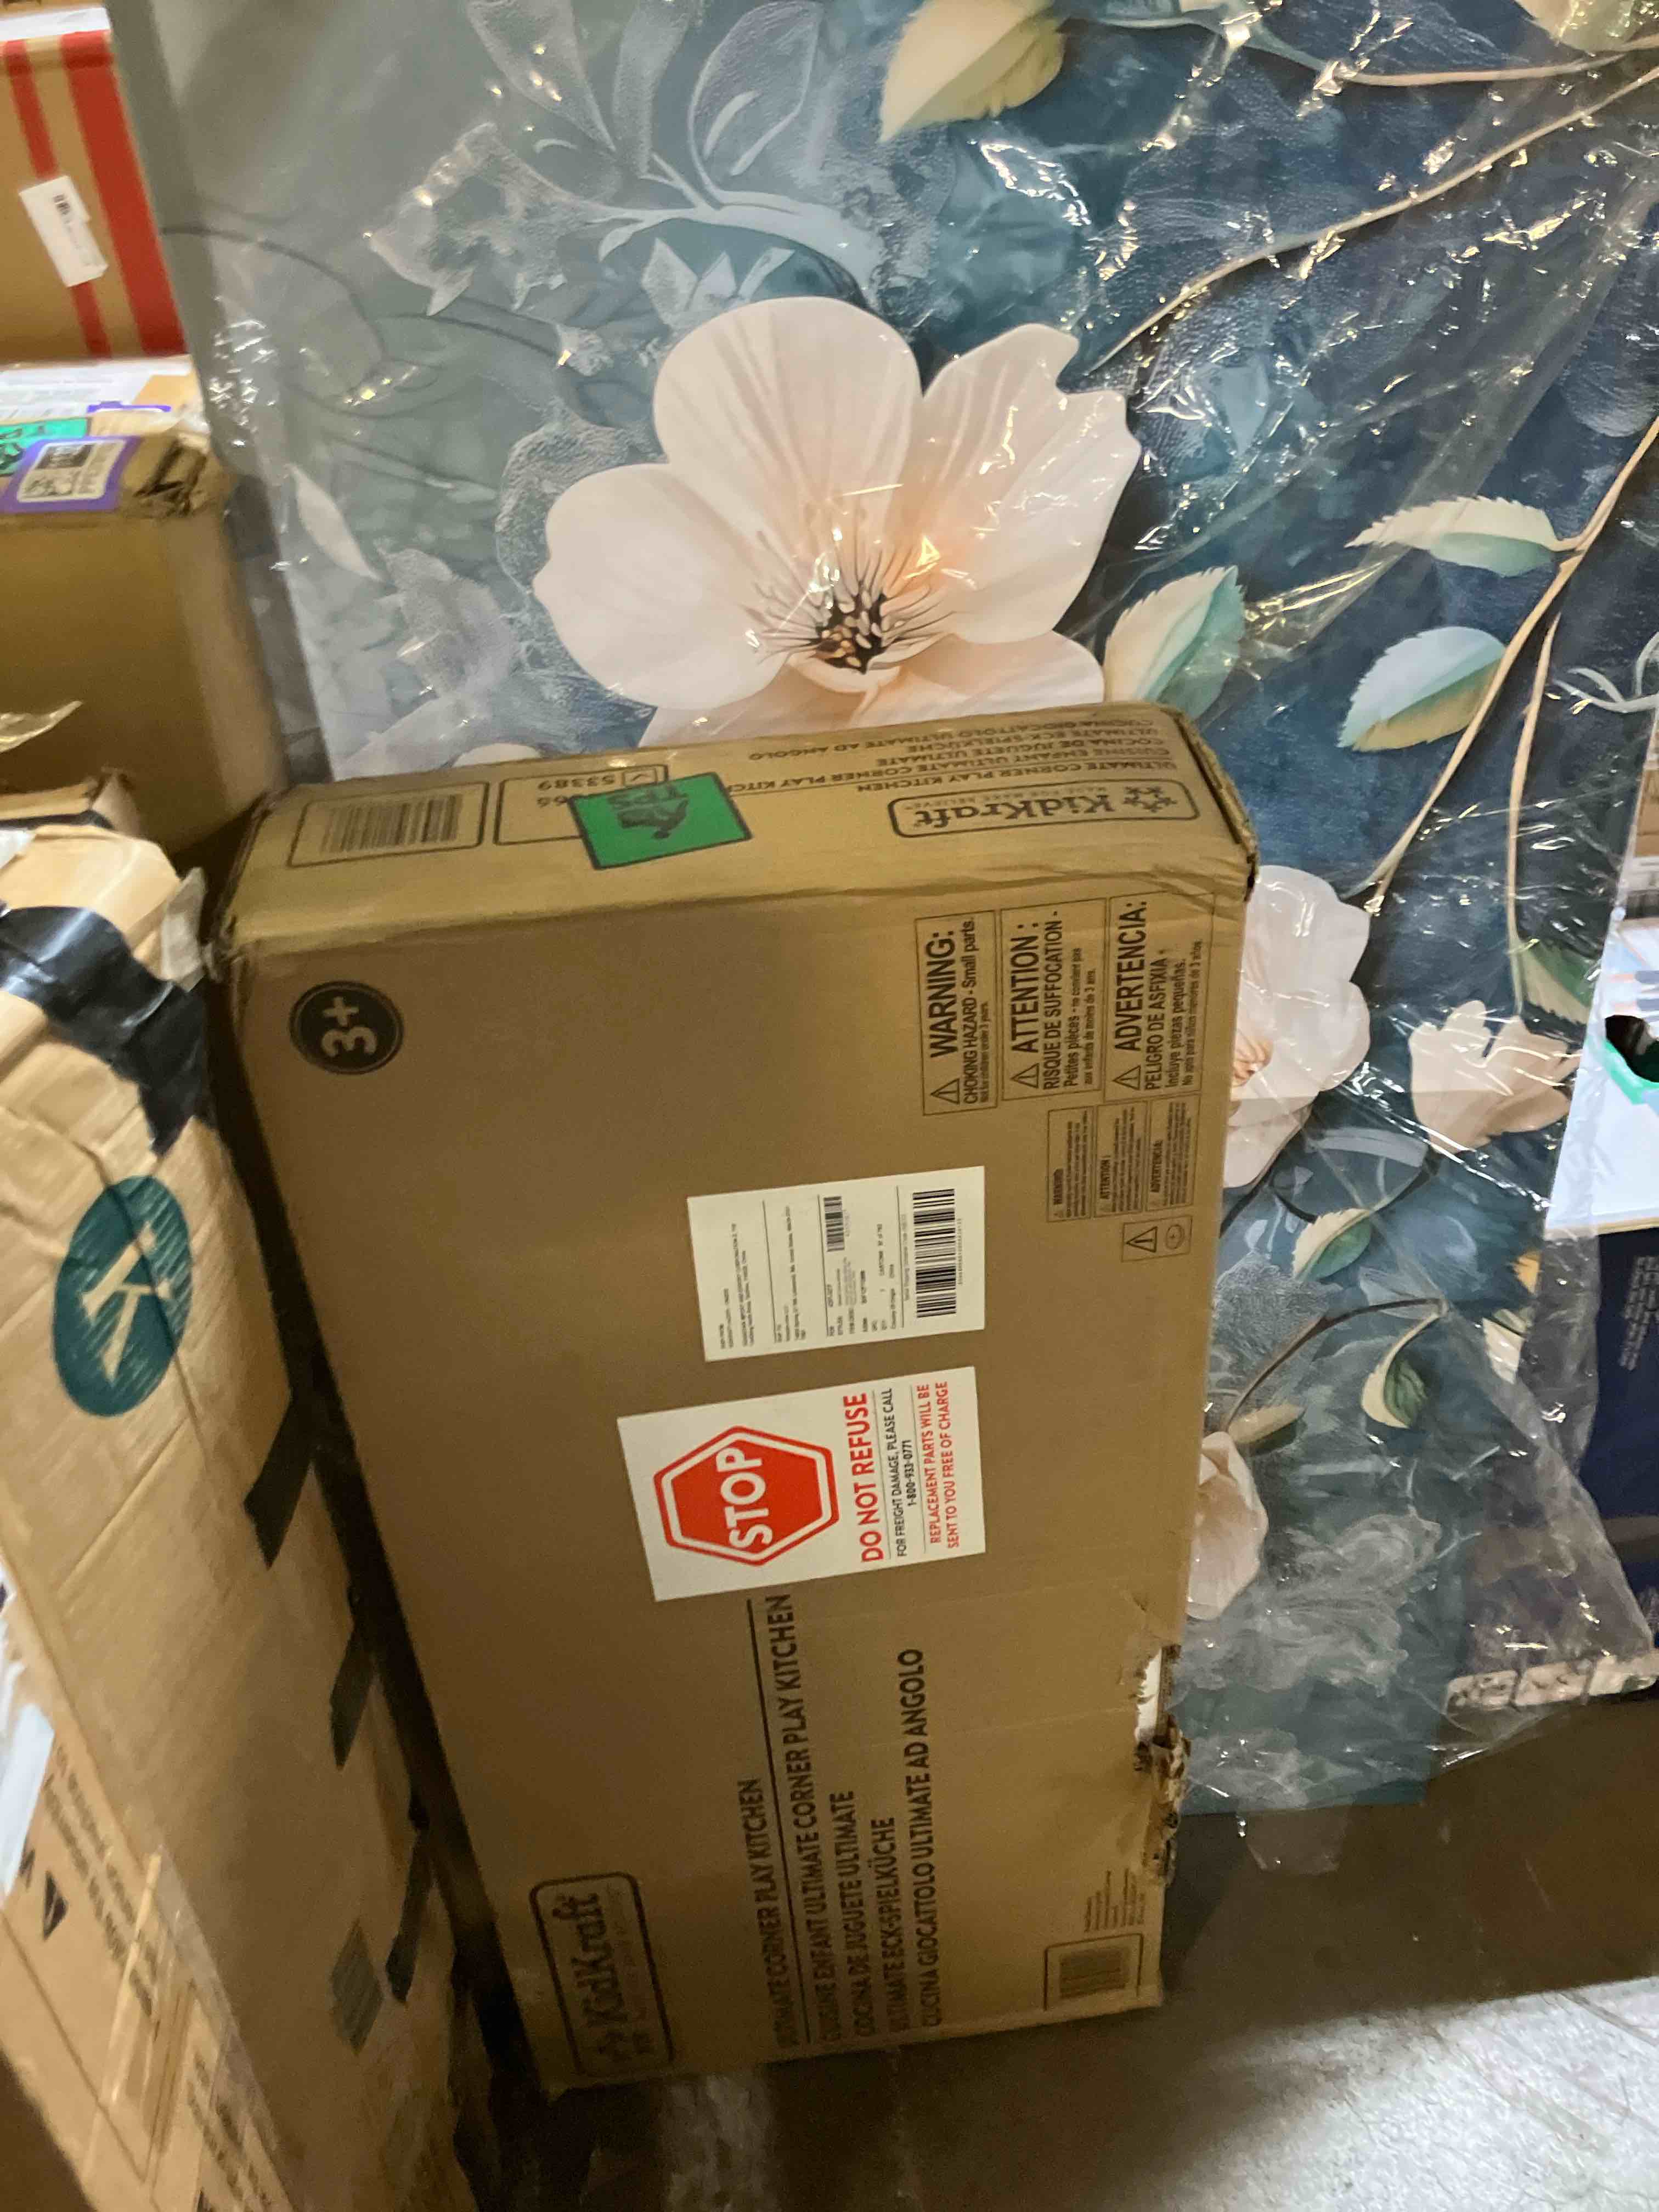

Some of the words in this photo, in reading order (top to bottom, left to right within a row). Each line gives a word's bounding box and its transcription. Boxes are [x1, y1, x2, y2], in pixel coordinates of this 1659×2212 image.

[749, 746, 830, 761] ANGOLO
[834, 742, 860, 752] AD
[865, 732, 953, 749] ULTIMATE
[876, 750, 967, 767] ULTIMATE
[972, 742, 1054, 755] JUGUETE
[1015, 749, 1088, 762] ENFANT
[781, 775, 826, 787] PLAY
[832, 767, 912, 782] CORNER
[917, 755, 1008, 772] ULTIMATE
[949, 771, 994, 783] PLAY
[1000, 764, 1081, 777] CORNER
[1087, 761, 1177, 770] ULTIMATE
[727, 781, 775, 792] KITC
[856, 776, 943, 792] KITCHEN
[913, 793, 1116, 828] KidKraft
[961, 955, 977, 990] Small
[1044, 920, 1063, 1017] SUFFOCATION
[1115, 901, 1147, 1052] ADVERTENCIA:
[1148, 957, 1168, 1010] ASFIXIA
[925, 931, 958, 1058] WARNING:
[1010, 935, 1040, 1053] ATTENTION
[1083, 994, 1094, 1005] de
[321, 996, 379, 1058] 3+
[962, 997, 977, 1048] HAZARD
[1044, 1020, 1062, 1040] DE
[1147, 1013, 1165, 1032] DE
[1169, 1015, 1184, 1049] piezas
[963, 1050, 978, 1104] CHOKING
[1043, 1041, 1060, 1090] RISQUE
[1064, 1052, 1079, 1088] Petites
[1144, 1034, 1163, 1091] PELIGRO
[1165, 1052, 1184, 1088] Incluye
[881, 1387, 894, 1414] CALL
[917, 1383, 929, 1400] BE
[935, 1381, 951, 1431] CHARGE
[884, 1414, 898, 1451] PLEASE
[919, 1401, 933, 1430] WILL
[843, 1392, 876, 1476] REFUSE
[921, 1429, 935, 1465] PARTS
[939, 1432, 953, 1449] OF
[887, 1452, 902, 1496] DAMAGE,
[901, 1438, 917, 1508] 1-800-933-0771
[940, 1449, 955, 1479] FREE
[715, 1447, 774, 1548] STOP
[854, 1482, 881, 1526] NOT
[924, 1466, 942, 1544] REPLACEMENT
[943, 1480, 956, 1505] YOU
[891, 1498, 906, 1538] FREIGHT
[945, 1505, 958, 1523] TO
[859, 1530, 884, 1563] DO
[895, 1538, 907, 1558] FOR
[946, 1523, 960, 1549] SENT
[765, 1594, 802, 1692] KITCHEN
[897, 1647, 929, 1737] ANGOLO
[778, 1697, 808, 1746] PLAY
[904, 1741, 930, 1769] AD
[785, 1748, 817, 1829] CORNER
[737, 1778, 772, 1859] KITCHEN
[830, 1790, 860, 1875] ULTIMATE
[904, 1773, 934, 1859] ULTIMATE
[748, 1863, 777, 1902] PLAY
[797, 1831, 827, 1915] ULTIMATE
[839, 1880, 870, 1953] JUGUETE
[912, 1862, 939, 1966] GIOCATTOLO
[808, 1917, 836, 1980] ENFANT
[847, 1956, 871, 1975] DE
